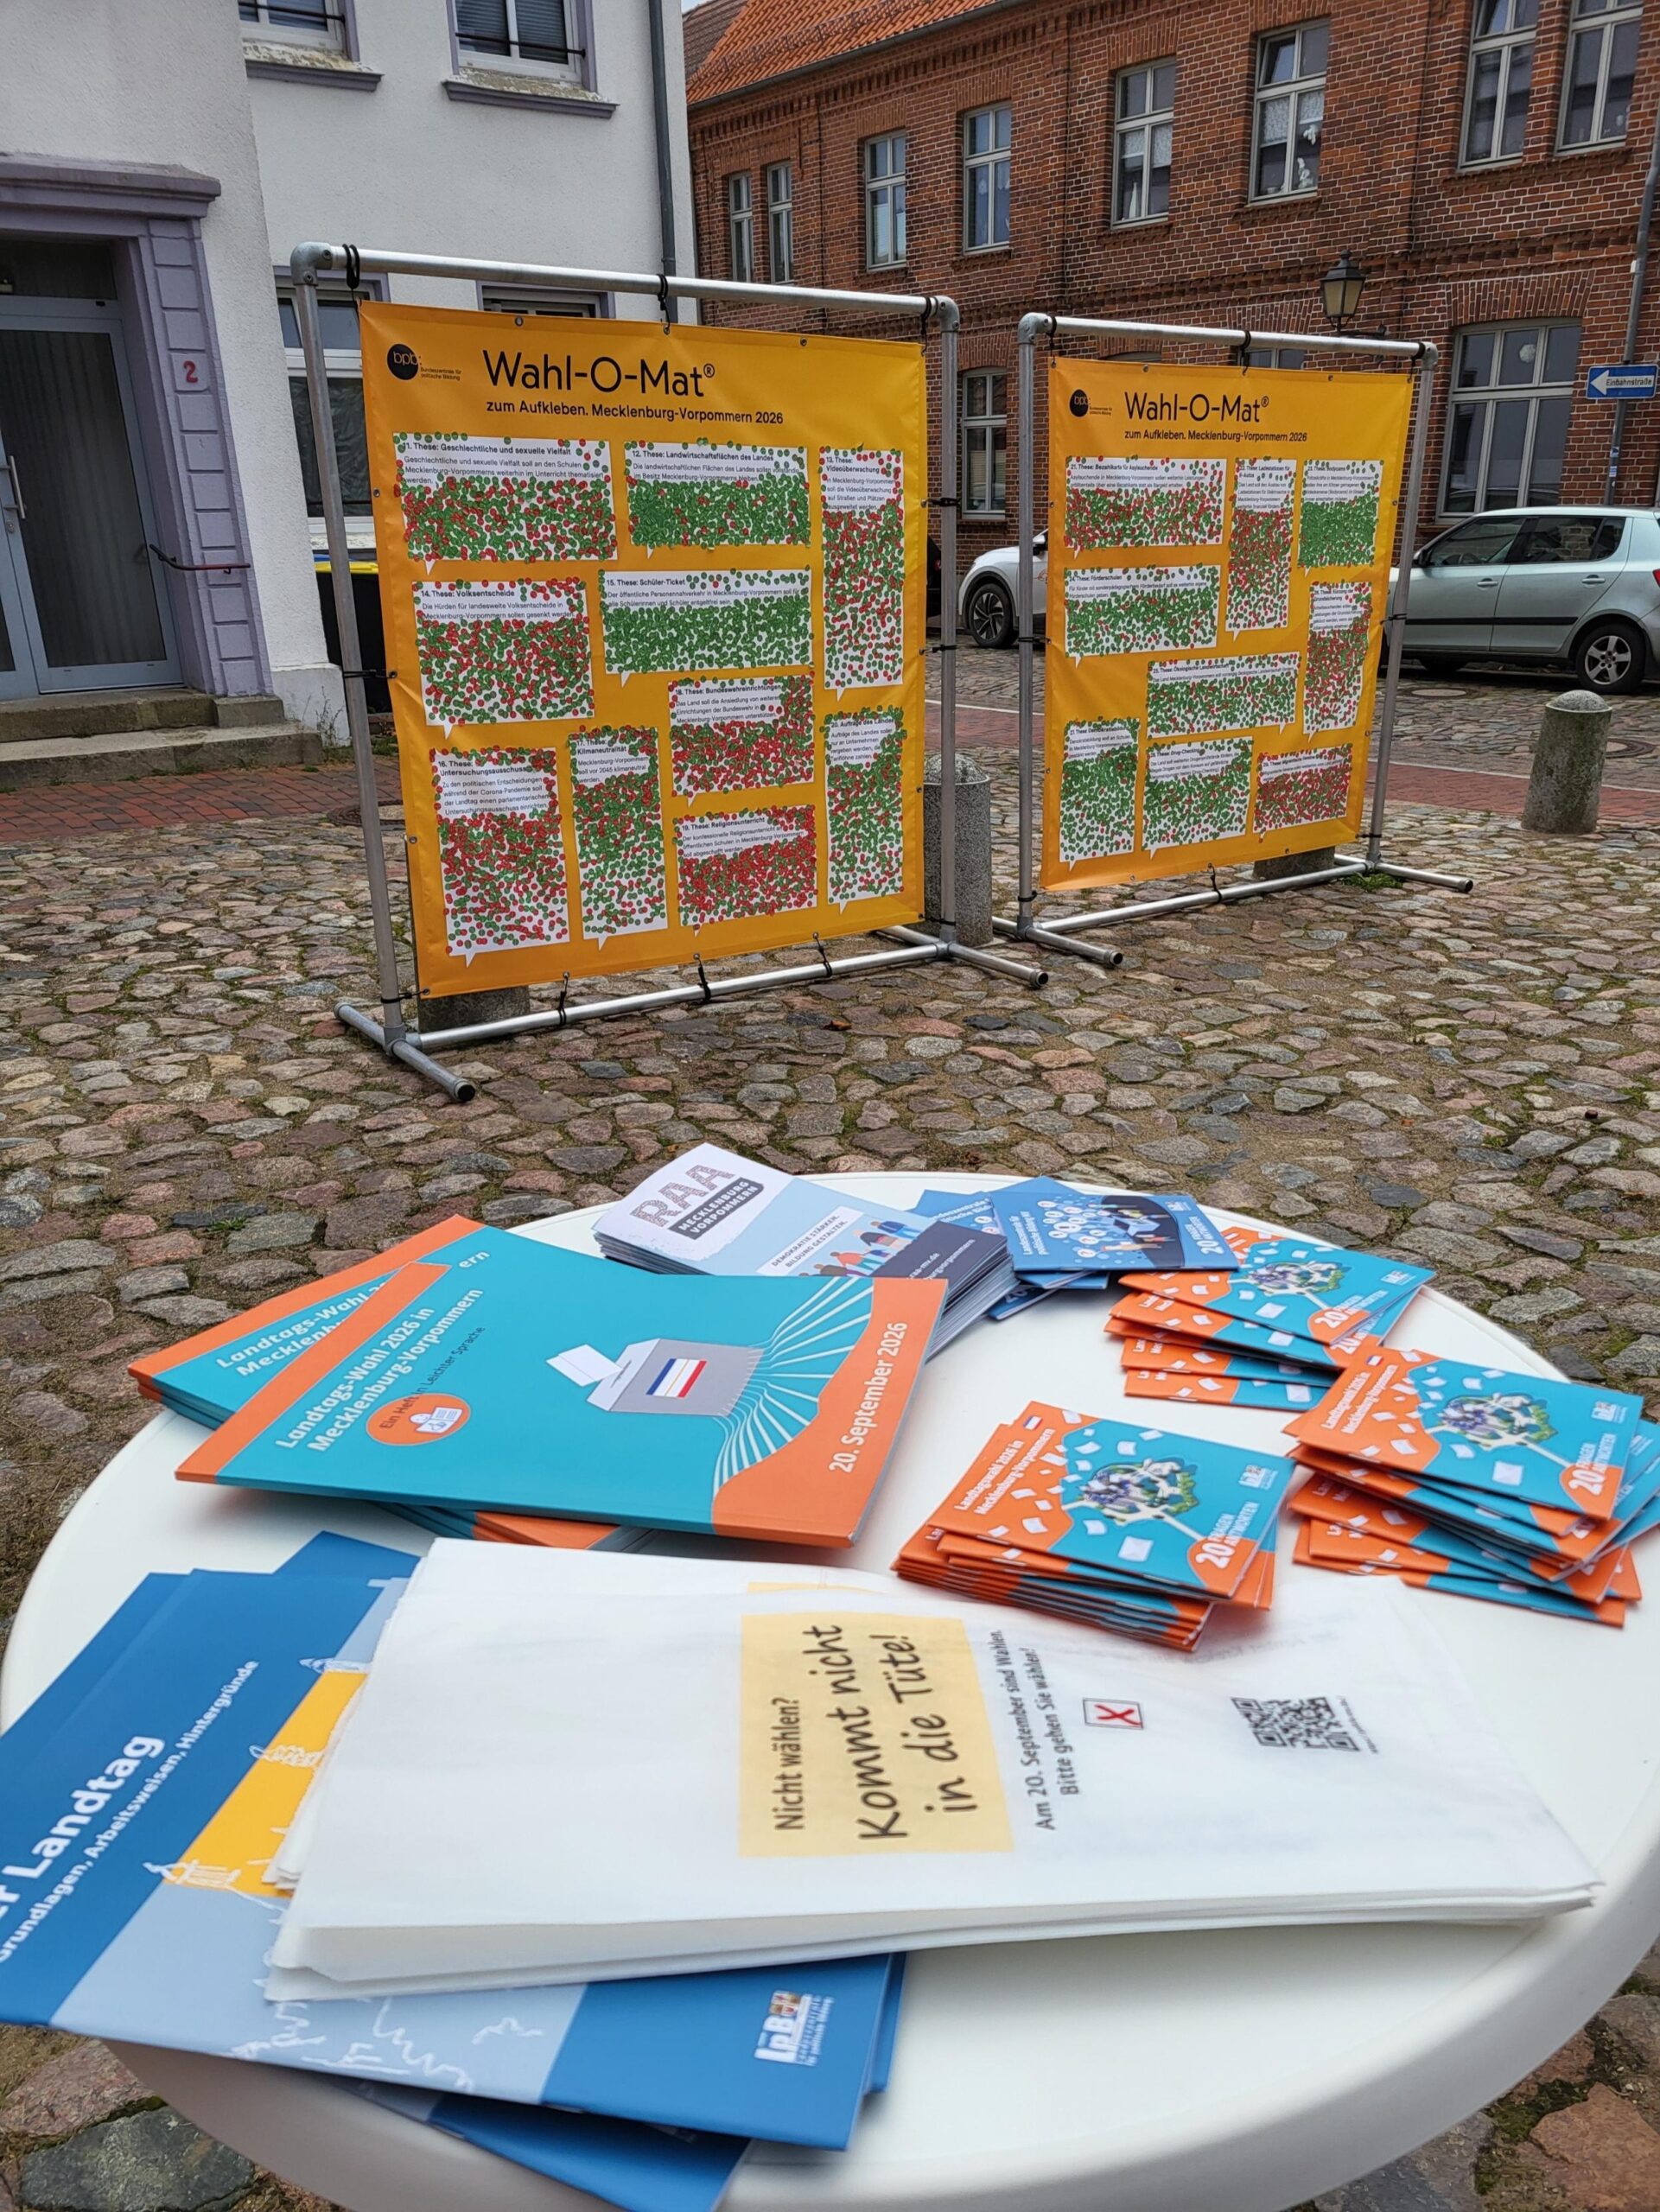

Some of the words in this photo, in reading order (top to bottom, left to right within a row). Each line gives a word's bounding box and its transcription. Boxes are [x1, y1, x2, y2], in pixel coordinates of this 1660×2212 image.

[183, 360, 199, 384] 2
[1606, 378, 1652, 386] Einbahnstraße
[487, 401, 515, 412] zum
[519, 400, 588, 416] Aufkleben.
[591, 404, 753, 423] Mecklenburg-Vorpommern
[755, 411, 784, 424] 2026
[414, 442, 439, 451] These:
[441, 443, 498, 454] Geschlechtliche
[515, 447, 545, 455] sexuelle
[547, 447, 571, 455] Vielfalt
[666, 451, 739, 461] Landwirtschaftsflächen
[1124, 430, 1142, 440] zum
[1143, 429, 1186, 440] Aufkleben.
[1188, 430, 1288, 442] Mecklenburg-Vorpommern
[1289, 432, 1307, 442] 2026
[404, 455, 457, 465] Geschlechtliche
[639, 577, 685, 586] Schüler-Ticket
[629, 1164, 735, 1228] RAA
[678, 1179, 750, 1231] MECKLENBURG
[690, 1185, 758, 1234] VORPOMMERN
[771, 1239, 811, 1267] DEMOKRATIE
[810, 1214, 840, 1242] STÄRKEN.
[785, 1245, 815, 1268] BILDUNG
[812, 1219, 848, 1248] GESTALTEN.
[1196, 1241, 1224, 1254] 20
[216, 1293, 368, 1368] Landtags-Wahl
[877, 1322, 907, 1357] 2026
[1314, 1311, 1349, 1328] 20
[275, 1349, 391, 1449] Landtags-Wahl
[380, 1320, 420, 1349] 2026
[410, 1308, 435, 1320] in
[306, 1289, 484, 1452] Mecklenburg-Vorpommern
[378, 1414, 396, 1428] Ein
[420, 1356, 456, 1385] Leichter
[451, 1327, 485, 1355] Sprache
[841, 1359, 894, 1446] September
[829, 1450, 860, 1473] 20.
[954, 1463, 1004, 1510] Landtagswahl
[995, 1447, 1018, 1465] 2026
[974, 1428, 1055, 1515] Mecklenburg-Vorpommern
[1568, 1469, 1605, 1496] 20
[1224, 1501, 1259, 1547] ANTWORTEN
[1195, 1542, 1236, 1568] 20
[803, 1624, 861, 1695] nicht
[868, 1633, 932, 1705] Tüte!
[989, 1630, 1012, 1666] Wahlen.
[1018, 1647, 1048, 1690] wählen!
[996, 1669, 1021, 1693] sind
[1035, 1692, 1056, 1711] Sie
[771, 1696, 803, 1769] wählen?
[901, 1713, 958, 1762] die
[1008, 1696, 1041, 1766] September
[1044, 1713, 1074, 1754] gehen
[84, 1751, 188, 1859] Arbeitsweisen,
[175, 1659, 259, 1749] Hintergründe
[827, 1705, 908, 1840] Kommt
[1056, 1758, 1079, 1796] Bitte
[774, 1772, 805, 1832] Nicht
[924, 1776, 978, 1814] in
[1025, 1770, 1046, 1797] 20.
[2, 1734, 165, 1880] Landtag
[1035, 1802, 1056, 1831] Am
